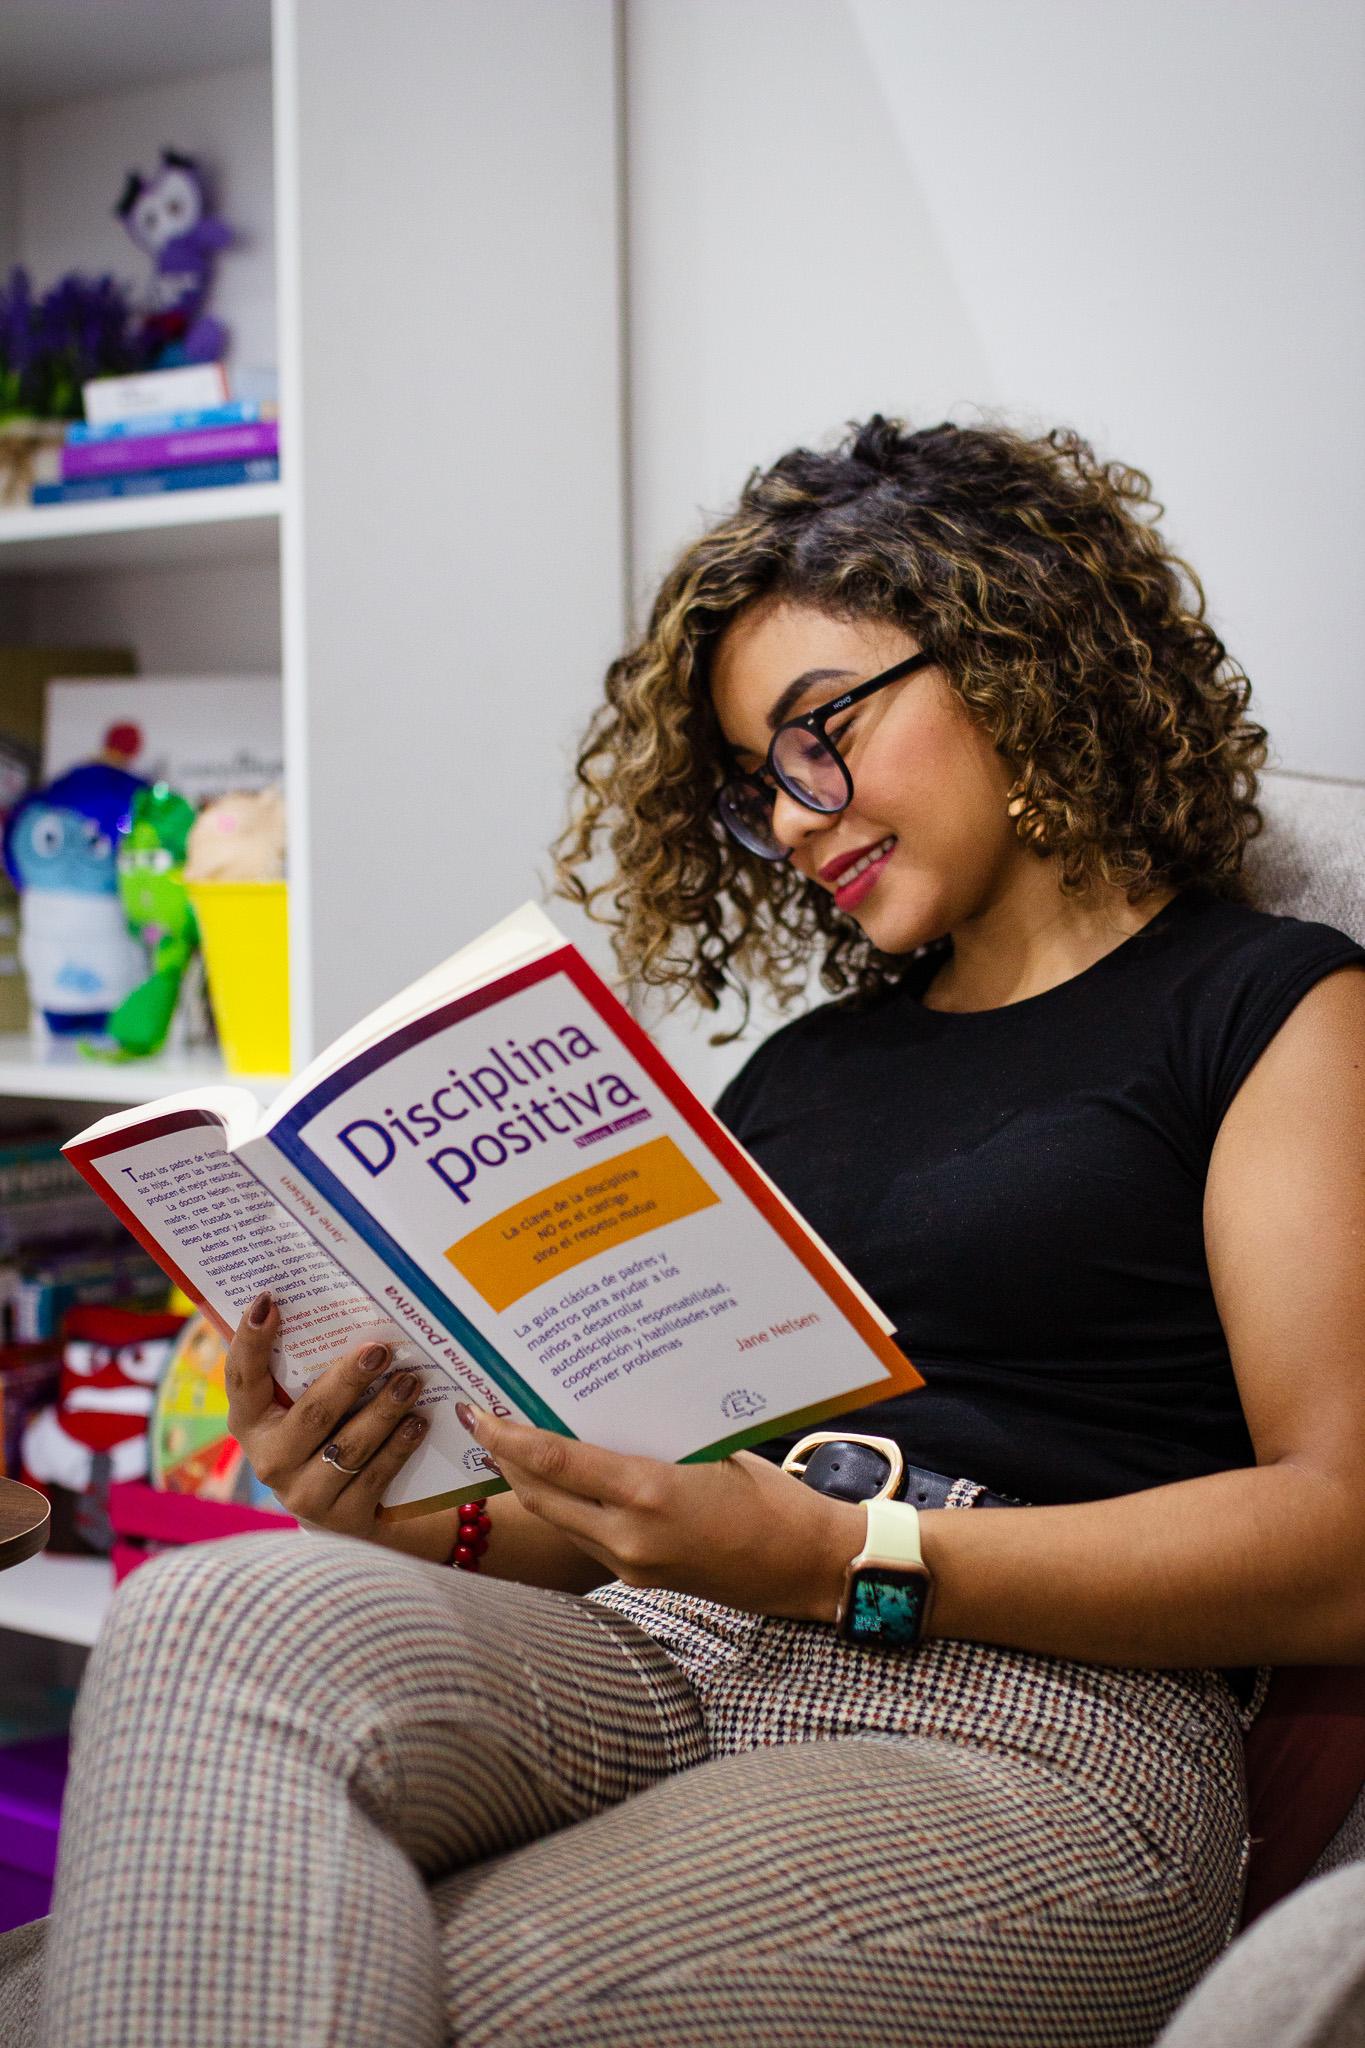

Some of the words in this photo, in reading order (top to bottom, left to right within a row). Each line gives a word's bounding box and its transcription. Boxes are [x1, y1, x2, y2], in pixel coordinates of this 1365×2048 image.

[336, 1024, 600, 1178] Disciplina
[426, 1074, 640, 1205] positiva
[138, 1186, 150, 1195] sus
[150, 1178, 173, 1191] hijos,
[174, 1172, 191, 1183] pero
[192, 1167, 205, 1176] las
[205, 1160, 231, 1172] buenas
[155, 1166, 168, 1175] los
[169, 1158, 194, 1172] padres
[194, 1154, 205, 1162] de
[146, 1190, 180, 1206] producen
[179, 1186, 188, 1194] el
[187, 1179, 208, 1192] mejor
[165, 1203, 177, 1212] La
[179, 1193, 207, 1208] doctora
[279, 1176, 319, 1216] Nelsen
[502, 1226, 521, 1240] La
[520, 1208, 551, 1230] clave
[553, 1200, 569, 1212] de
[568, 1193, 583, 1204] la
[584, 1169, 640, 1198] disciplina
[163, 1213, 191, 1226] madre,
[192, 1206, 209, 1217] cree
[211, 1200, 226, 1210] que
[226, 1195, 240, 1205] los
[172, 1222, 200, 1236] sienten
[200, 1212, 232, 1227] frustada
[233, 1208, 243, 1216] su
[537, 1224, 557, 1241] NO
[587, 1190, 629, 1216] castigo
[181, 1235, 203, 1247] deseo
[202, 1231, 213, 1240] de
[212, 1225, 231, 1236] amor
[232, 1223, 239, 1231] y
[200, 1239, 230, 1254] Además
[232, 1233, 246, 1242] nos
[249, 1224, 276, 1238] explica
[318, 1215, 347, 1243] Jane
[533, 1245, 559, 1264] sino
[560, 1236, 573, 1249] el
[574, 1216, 619, 1242] respeto
[198, 1245, 250, 1267] cariñosamente
[205, 1259, 247, 1277] habilidades
[247, 1254, 265, 1265] para
[265, 1249, 275, 1257] la
[215, 1278, 227, 1287] ser
[224, 1286, 245, 1297] ducta
[245, 1284, 252, 1292] y
[252, 1270, 290, 1288] capacidad
[290, 1266, 308, 1277] para
[275, 1279, 306, 1294] muestra
[309, 1272, 330, 1283] cómo
[288, 1292, 306, 1304] paso
[306, 1289, 313, 1297] a
[312, 1284, 333, 1296] paso,
[513, 1323, 532, 1339] La
[532, 1305, 559, 1329] guía
[559, 1282, 600, 1310] clásica
[601, 1273, 618, 1288] de
[618, 1255, 659, 1281] padres
[658, 1251, 668, 1264] y
[286, 1310, 312, 1323] enseñar
[318, 1305, 330, 1313] los
[302, 1321, 314, 1329] sin
[313, 1311, 340, 1325] recurrir
[384, 1285, 449, 1346] positiva
[527, 1312, 582, 1352] maestros
[581, 1298, 610, 1319] para
[610, 1276, 650, 1302] ayudar
[651, 1274, 661, 1284] a
[659, 1265, 681, 1280] los
[299, 1335, 325, 1348] errores
[324, 1326, 354, 1339] cometen
[538, 1338, 572, 1365] niños
[572, 1332, 582, 1343] a
[582, 1298, 645, 1337] desarrollar
[562, 1341, 634, 1390] cooperación
[633, 1337, 643, 1350] y
[642, 1306, 710, 1344] habilidades
[709, 1296, 739, 1317] para
[735, 1331, 770, 1353] Jane
[768, 1311, 822, 1339] Nelsen
[318, 1343, 330, 1352] del
[550, 1323, 637, 1378] autodisciplina,
[442, 1347, 512, 1418] Disciplina
[573, 1366, 621, 1402] resolver
[622, 1337, 684, 1375] problemas
